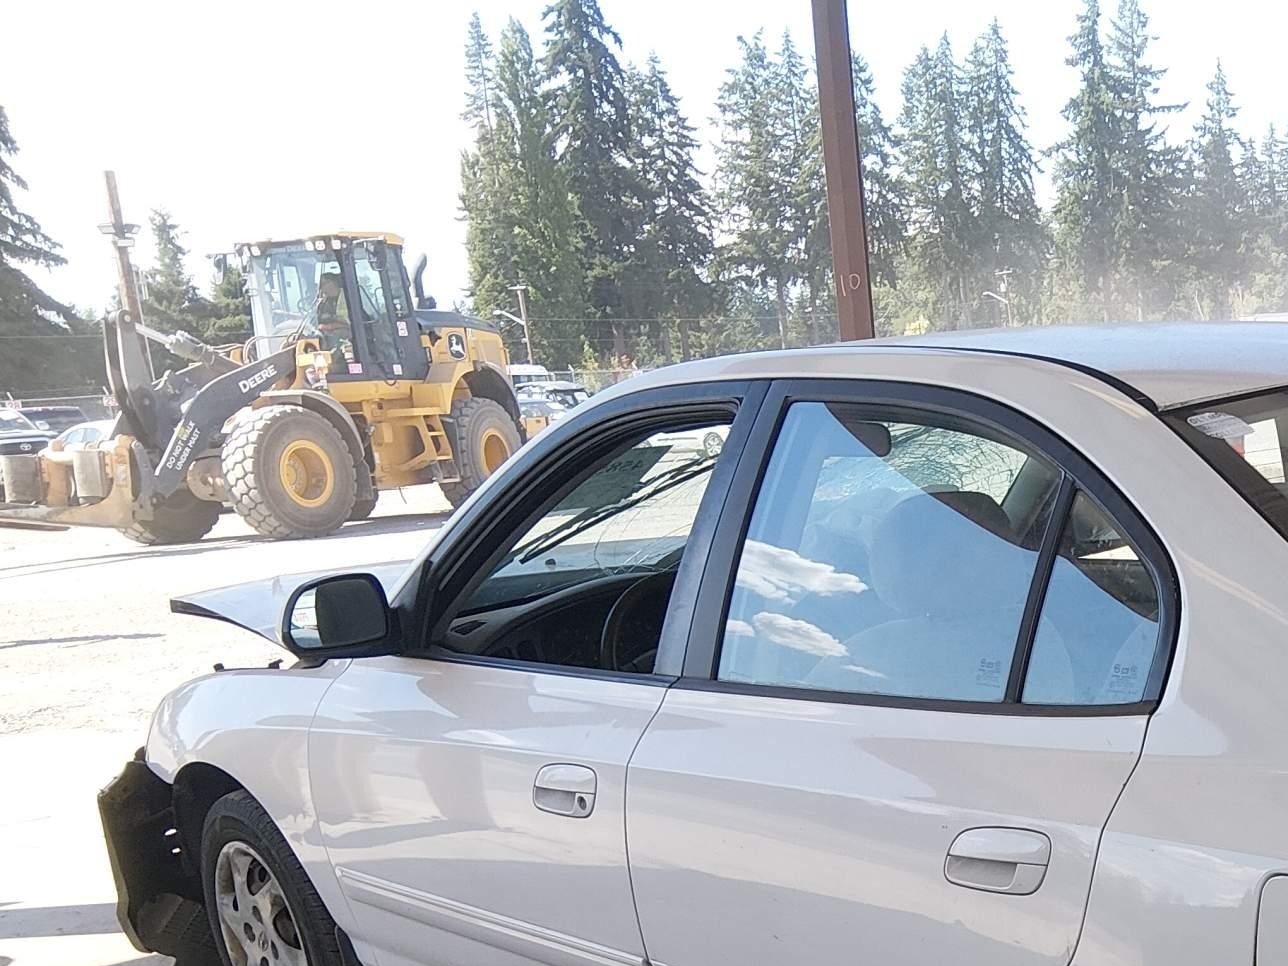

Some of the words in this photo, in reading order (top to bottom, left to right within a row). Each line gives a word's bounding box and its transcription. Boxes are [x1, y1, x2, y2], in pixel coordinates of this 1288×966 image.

[840, 270, 861, 297] 10
[238, 364, 278, 394] DEERE
[166, 456, 176, 470] DO
[172, 439, 185, 458] NOT
[175, 446, 192, 470] UNDER
[187, 427, 201, 448] MAST
